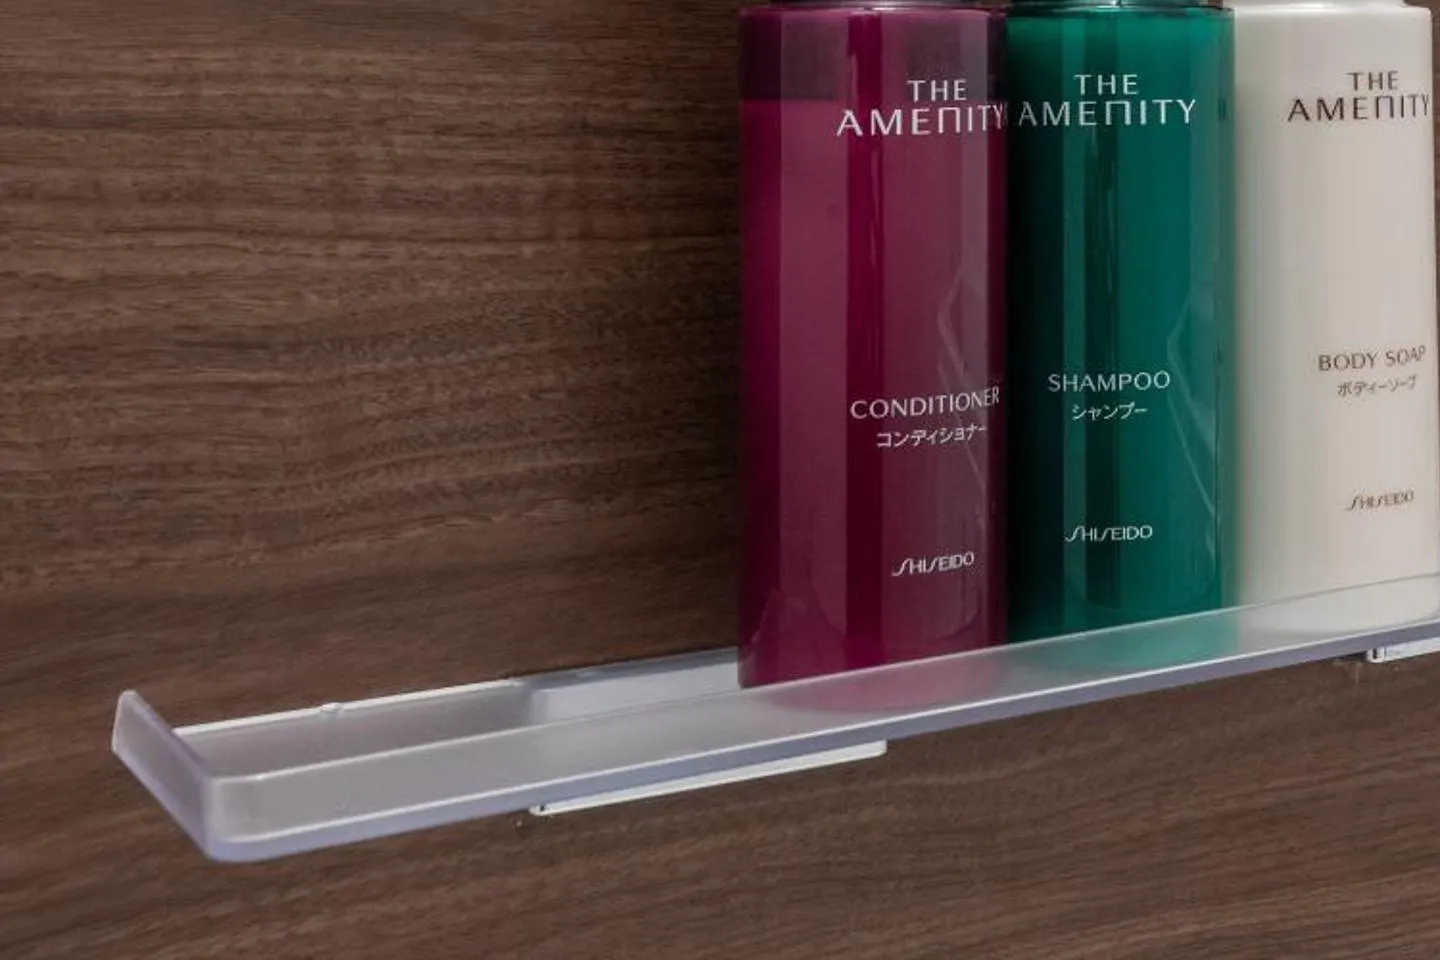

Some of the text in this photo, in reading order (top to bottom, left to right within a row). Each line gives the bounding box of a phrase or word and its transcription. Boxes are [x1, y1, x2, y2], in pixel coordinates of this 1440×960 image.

[907, 79, 967, 102] THE
[1074, 74, 1139, 95] THE
[1346, 71, 1399, 91] THE
[1018, 98, 1197, 127] AMENITY
[1287, 93, 1430, 122] AMENITY
[836, 104, 1003, 137] AMENITY
[1318, 345, 1427, 371] BODY SOAP
[1047, 370, 1171, 392] SHAMPOO
[1337, 374, 1418, 397] ボディーソープ
[850, 385, 1000, 419] CONDITIONER
[1072, 401, 1148, 421] シャンプー
[876, 422, 988, 448] コンディショナー
[1344, 489, 1415, 512] SHISEIDO
[1064, 524, 1154, 542] SHISEIDO
[891, 550, 976, 577] SHISEIDO
